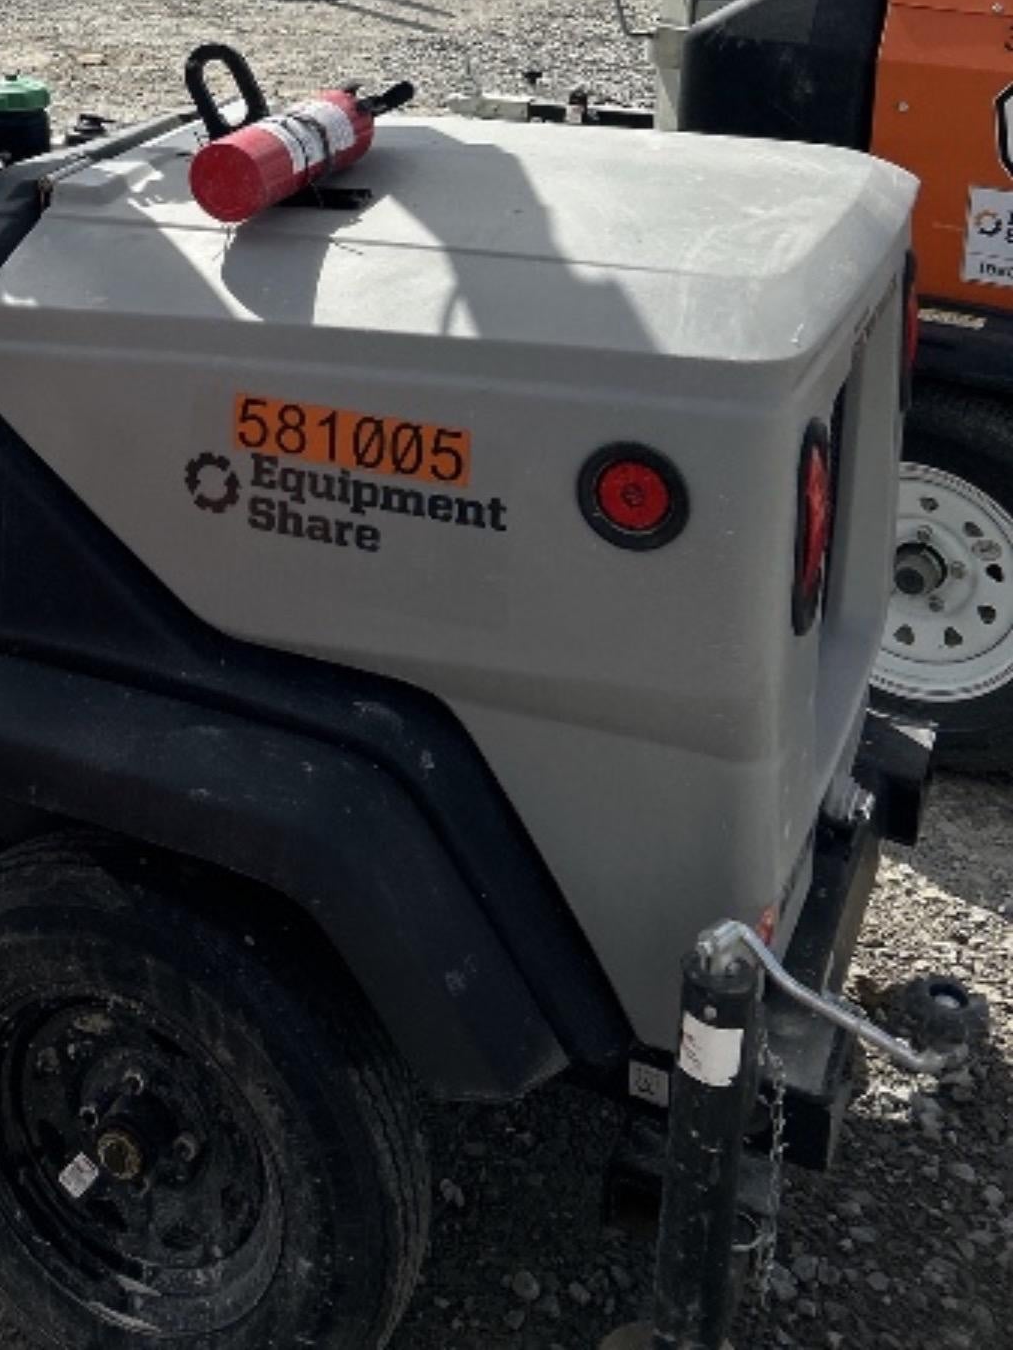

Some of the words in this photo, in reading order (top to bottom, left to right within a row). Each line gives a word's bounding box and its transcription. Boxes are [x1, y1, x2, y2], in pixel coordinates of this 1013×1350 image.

[237, 397, 464, 483] 581005
[247, 495, 382, 553] Share
[249, 452, 508, 532] Equipment
